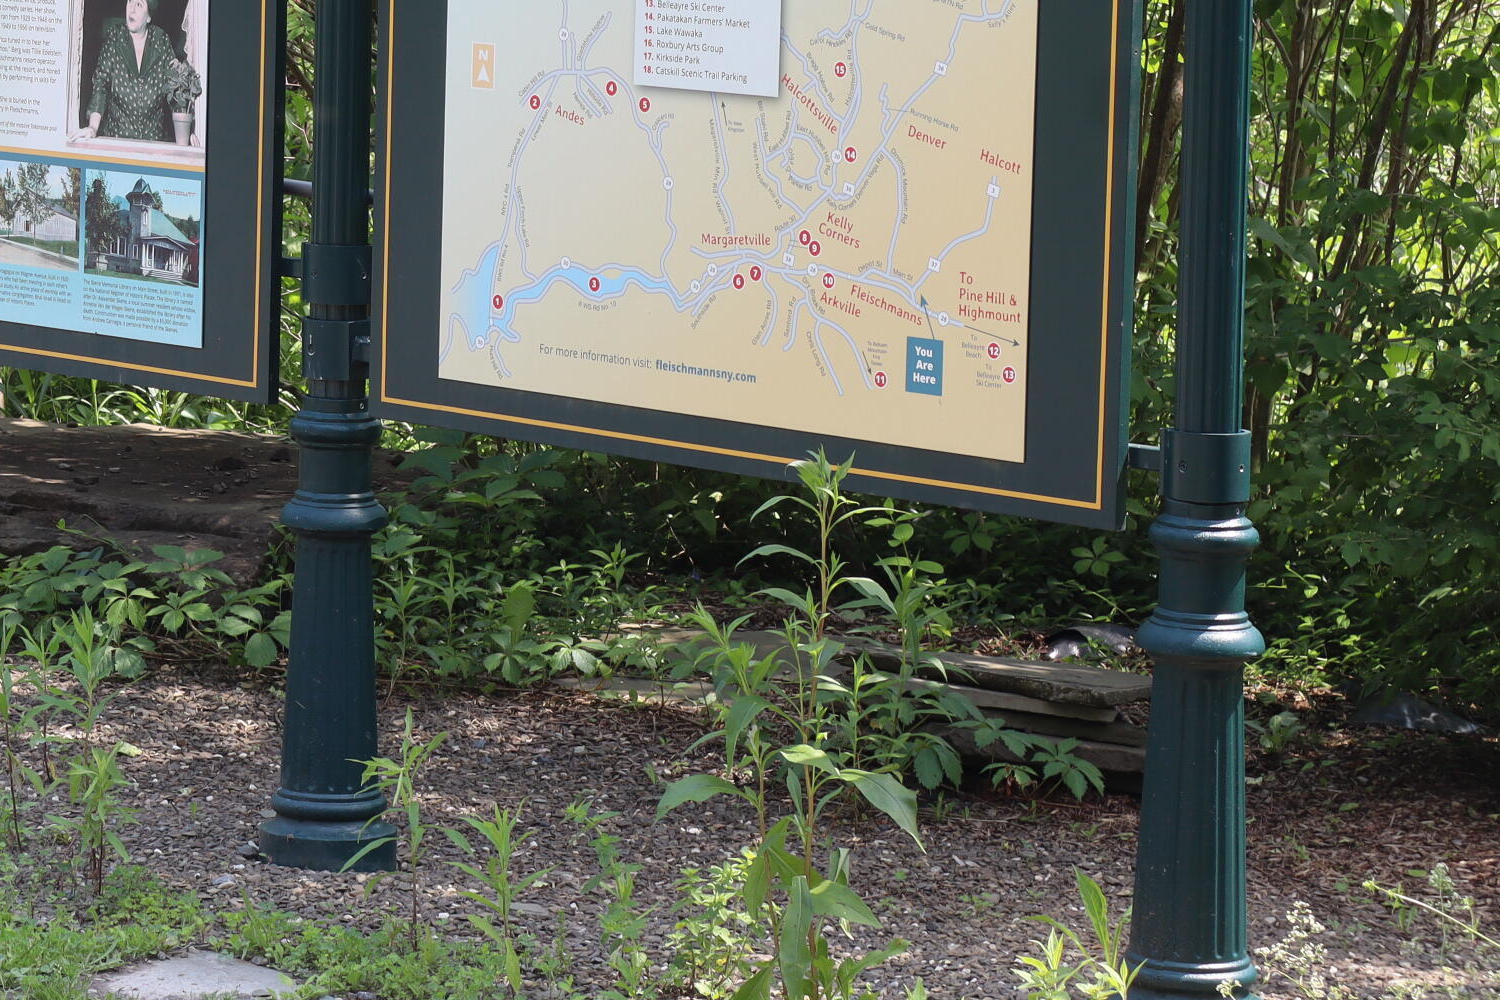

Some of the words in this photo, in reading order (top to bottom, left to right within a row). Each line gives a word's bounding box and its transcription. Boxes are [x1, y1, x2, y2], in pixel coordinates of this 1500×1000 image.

[644, 26, 655, 35] 15.
[657, 27, 673, 35] Lake
[674, 28, 703, 38] Wawaka
[478, 50, 488, 60] N
[644, 39, 655, 48] 16.
[656, 40, 684, 50] Roxbury
[686, 42, 700, 51] Arts
[702, 44, 724, 54] Group
[643, 66, 654, 74] 18.
[656, 67, 680, 76] Catskill
[681, 68, 703, 78] Scenic
[705, 70, 720, 79] Trail
[722, 72, 747, 84] Parking
[781, 73, 838, 135] Halcottsville
[555, 104, 585, 127] Andes
[908, 125, 947, 150] Denver
[980, 149, 1021, 175] Halcott
[827, 211, 853, 233] Kelly
[701, 233, 771, 246] Margaretville
[819, 222, 860, 249] Corners
[960, 272, 973, 284] To
[820, 292, 861, 318] Arkville
[851, 284, 922, 326] Fleischmanns
[960, 288, 982, 303] Pine
[985, 291, 1005, 305] Hill
[1010, 295, 1017, 306] &
[958, 305, 1021, 324] Highmount
[915, 346, 933, 358] You
[539, 344, 553, 354] For
[555, 348, 578, 358] more
[580, 350, 630, 365] information
[632, 359, 652, 368] visit:
[656, 360, 757, 382] fleischmannsny.com
[916, 359, 933, 371] Are
[912, 372, 936, 385] Here
